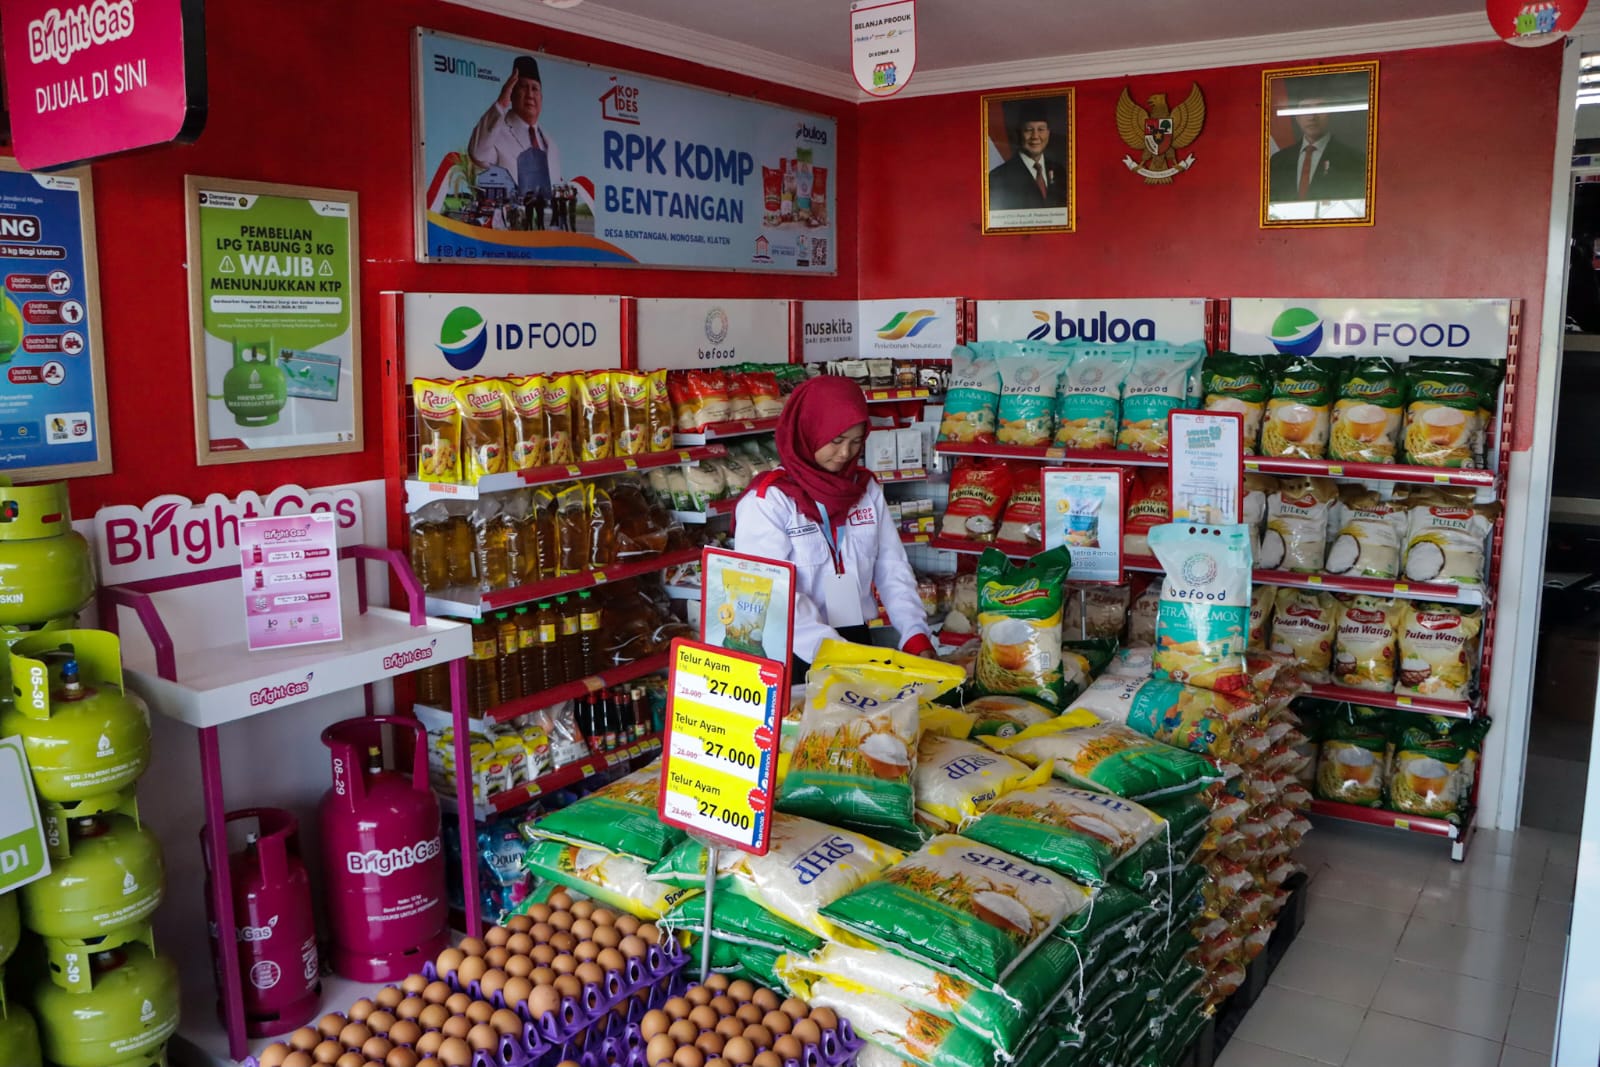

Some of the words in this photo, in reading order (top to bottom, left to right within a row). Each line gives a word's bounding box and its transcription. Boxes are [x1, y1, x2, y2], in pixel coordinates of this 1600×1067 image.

[854, 20, 883, 30] BELANJA
[884, 14, 911, 24] PRODUK
[36, 77, 88, 114] DIJUAL
[92, 70, 108, 99] DI
[114, 58, 147, 94] SINI
[617, 85, 639, 98] KOP
[617, 100, 639, 112] DES
[802, 123, 828, 145] bulog
[604, 130, 667, 176] RPK
[674, 140, 754, 186] KDMP
[604, 185, 744, 224] BENTANGAN
[240, 226, 313, 241] PEMBELIAN
[604, 229, 624, 238] DESA
[19, 248, 35, 257] Bagi
[36, 249, 60, 257] Usaha
[216, 238, 243, 251] LPG
[246, 240, 301, 254] TABUNG
[305, 243, 313, 254] 3
[316, 244, 335, 255] KG
[239, 254, 315, 277] WAJIB
[210, 278, 316, 292] MENUNJUKKAN
[319, 281, 342, 293] KTP
[496, 323, 523, 350] ID
[528, 322, 597, 349] FOOD
[804, 318, 853, 337] nusakita
[1333, 322, 1367, 346] ID
[1373, 323, 1470, 348] FOOD
[698, 347, 735, 360] befood
[1431, 517, 1467, 529] PULEN
[1168, 586, 1226, 601] befood
[1160, 605, 1187, 618] ETRA
[1299, 617, 1330, 632] Wangi
[1361, 625, 1393, 638] Wangi
[1404, 629, 1433, 641] Pulen
[1434, 632, 1468, 645] Wangi
[679, 651, 702, 665] Telur
[703, 657, 731, 673] Ayam
[31, 667, 45, 710] 05-30
[709, 679, 761, 706] 27.000
[675, 712, 698, 727] Telur
[699, 720, 726, 735] Ayam
[704, 741, 756, 769] 27.000
[829, 751, 839, 766] 5
[840, 755, 854, 769] kg
[333, 757, 346, 796] 08-29
[670, 771, 693, 786] Telur
[694, 780, 721, 796] Ayam
[699, 801, 750, 830] 27.000
[793, 836, 855, 885] SPHP
[961, 851, 1053, 886] SPHP
